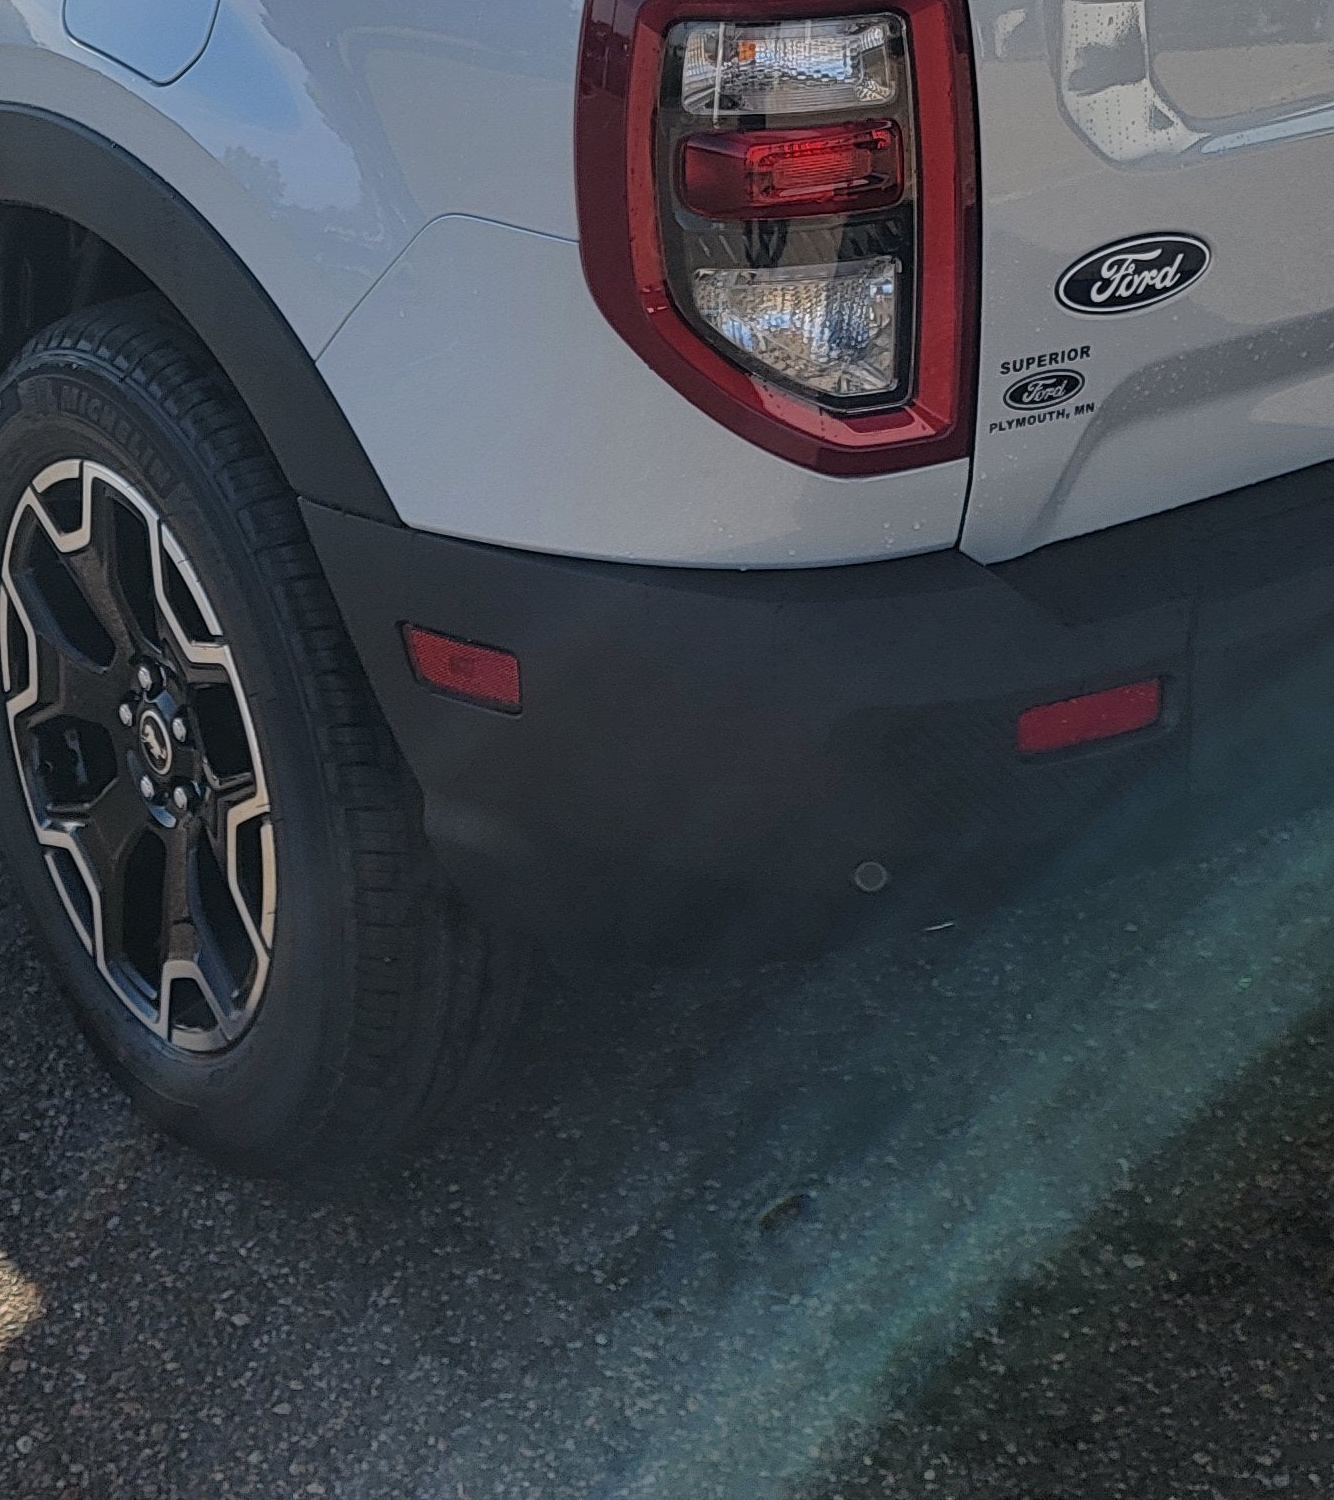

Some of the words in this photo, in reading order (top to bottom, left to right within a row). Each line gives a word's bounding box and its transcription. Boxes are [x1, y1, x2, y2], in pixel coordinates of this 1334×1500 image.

[1090, 248, 1184, 303] Ford
[1000, 345, 1091, 375] SUPERIOR
[1022, 378, 1066, 403] Ford
[989, 408, 1071, 435] PLYMOUTH,
[1073, 402, 1095, 416] MN
[60, 384, 172, 490] MICHELIN
